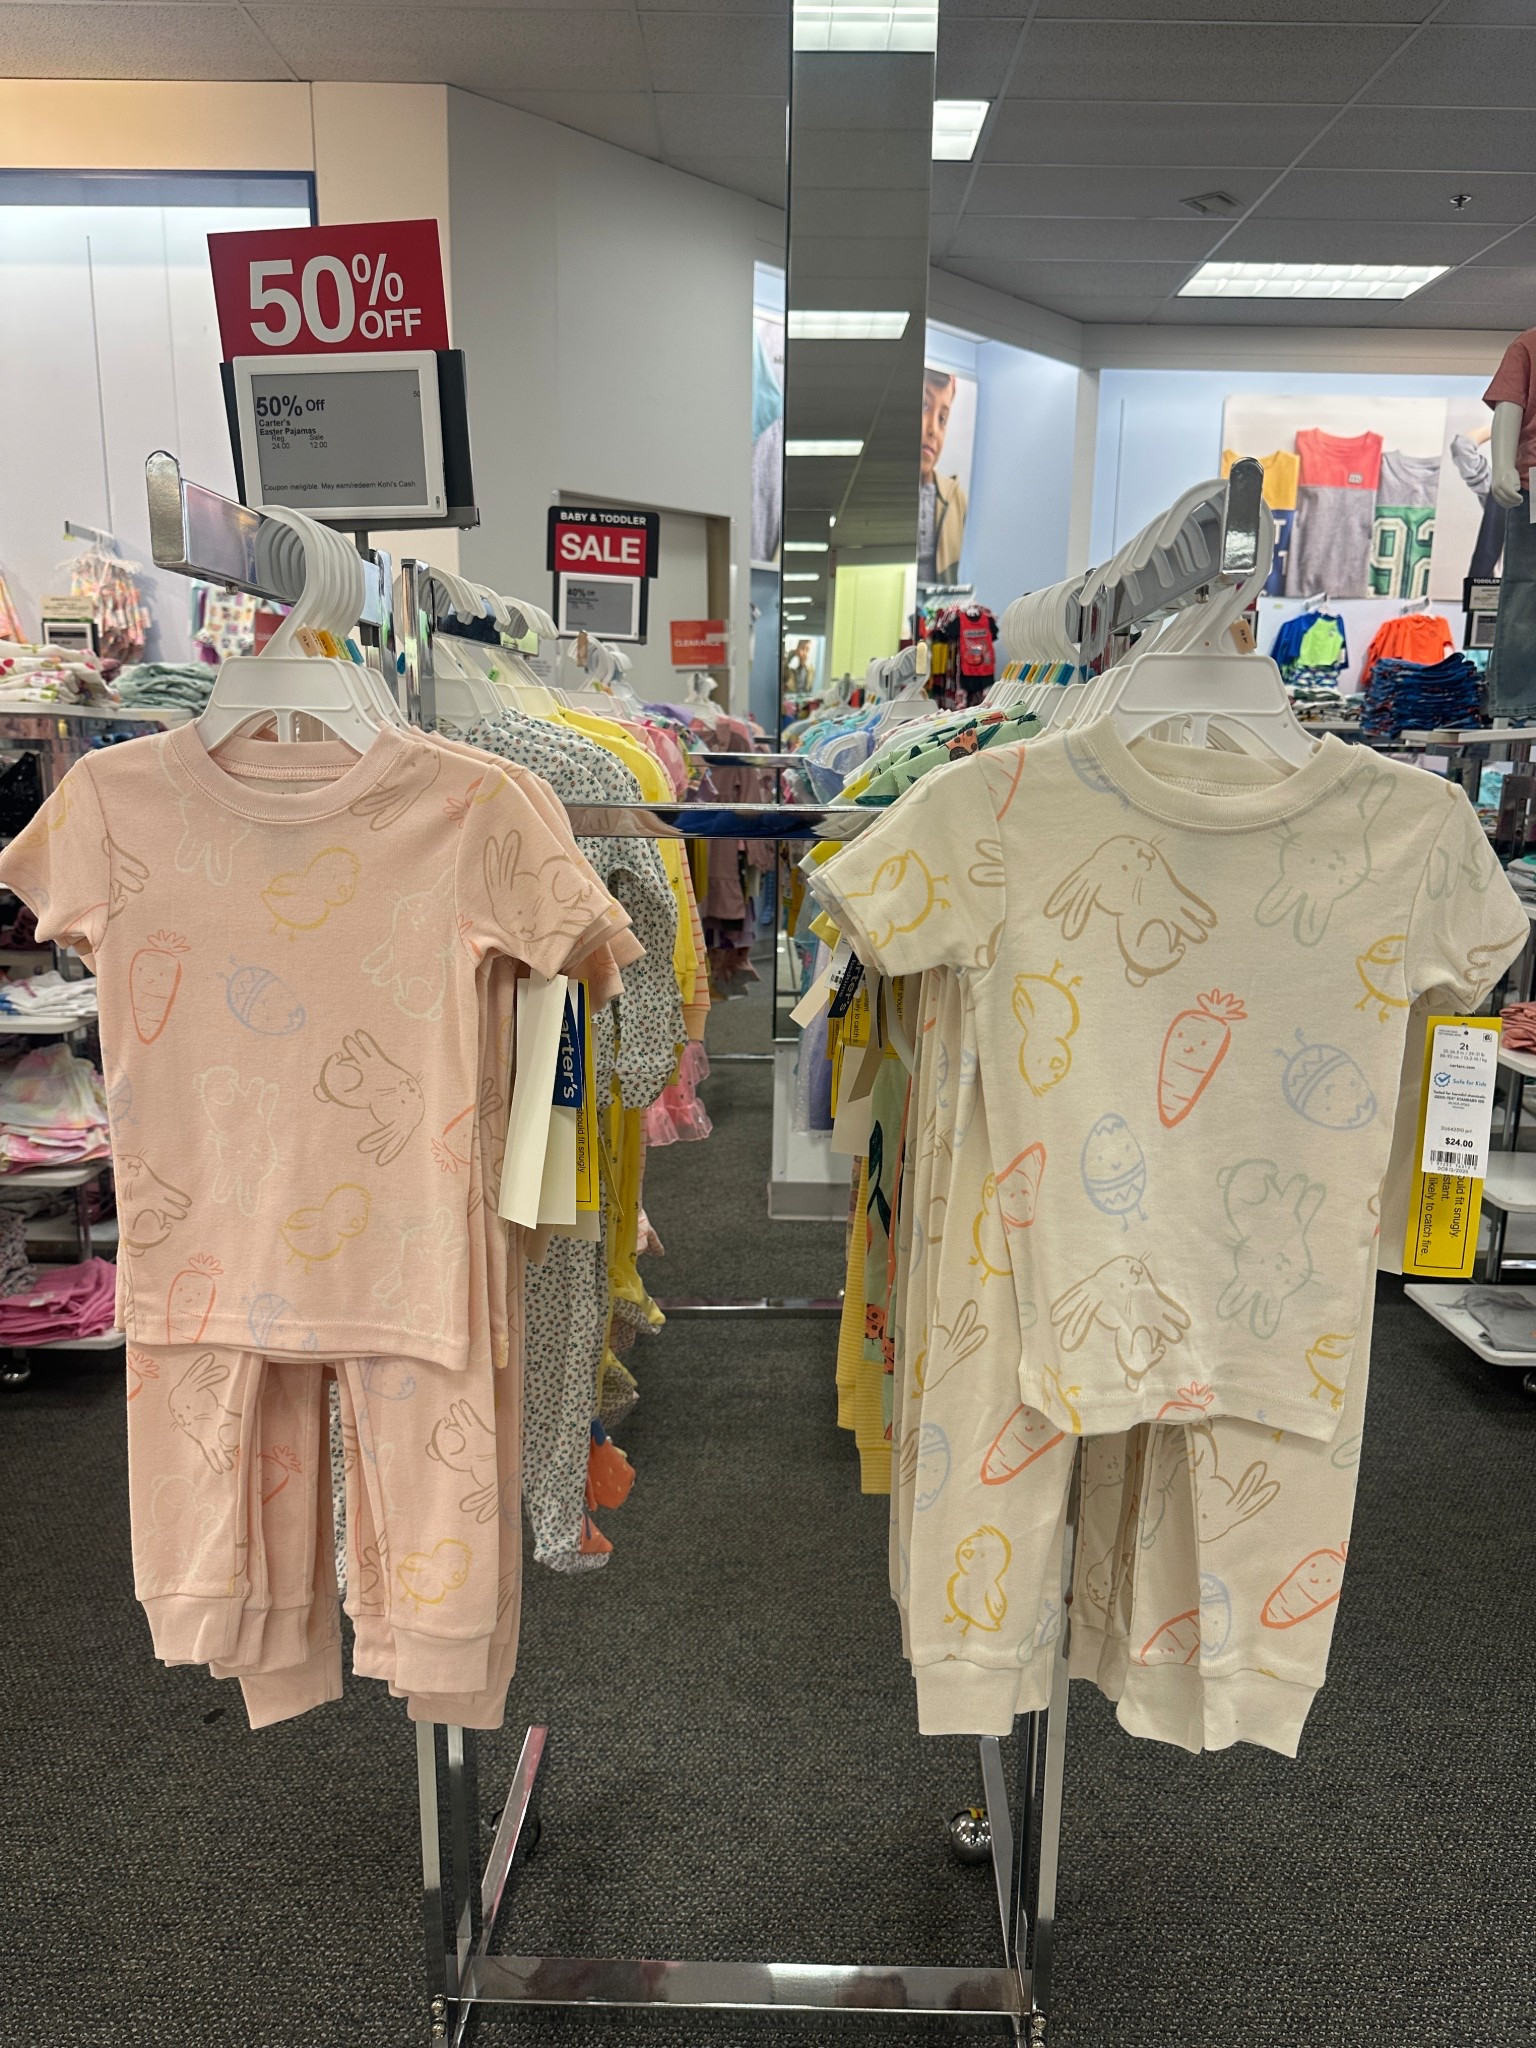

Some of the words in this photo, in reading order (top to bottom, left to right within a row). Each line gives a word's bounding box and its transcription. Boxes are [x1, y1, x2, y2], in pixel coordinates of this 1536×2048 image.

[250, 253, 404, 347] 50%
[359, 308, 422, 340] OFF
[256, 395, 302, 416] 50%
[306, 399, 325, 412] Off
[258, 419, 290, 427] Carter's
[285, 427, 316, 436] Pajamas
[322, 482, 334, 490] May
[560, 512, 588, 522] BABY
[590, 514, 597, 522] &
[599, 514, 646, 526] TODDLER
[560, 533, 641, 564] SALE
[561, 1012, 578, 1099] arter's
[1445, 1137, 1473, 1147] $24.00
[1425, 1177, 1438, 1200] likely
[1456, 1175, 1466, 1194] ould
[1426, 1203, 1435, 1211] to
[1455, 1197, 1464, 1206] fit
[1423, 1214, 1432, 1238] catch
[1449, 1208, 1462, 1238] snugly.
[1420, 1240, 1431, 1256] fire.
